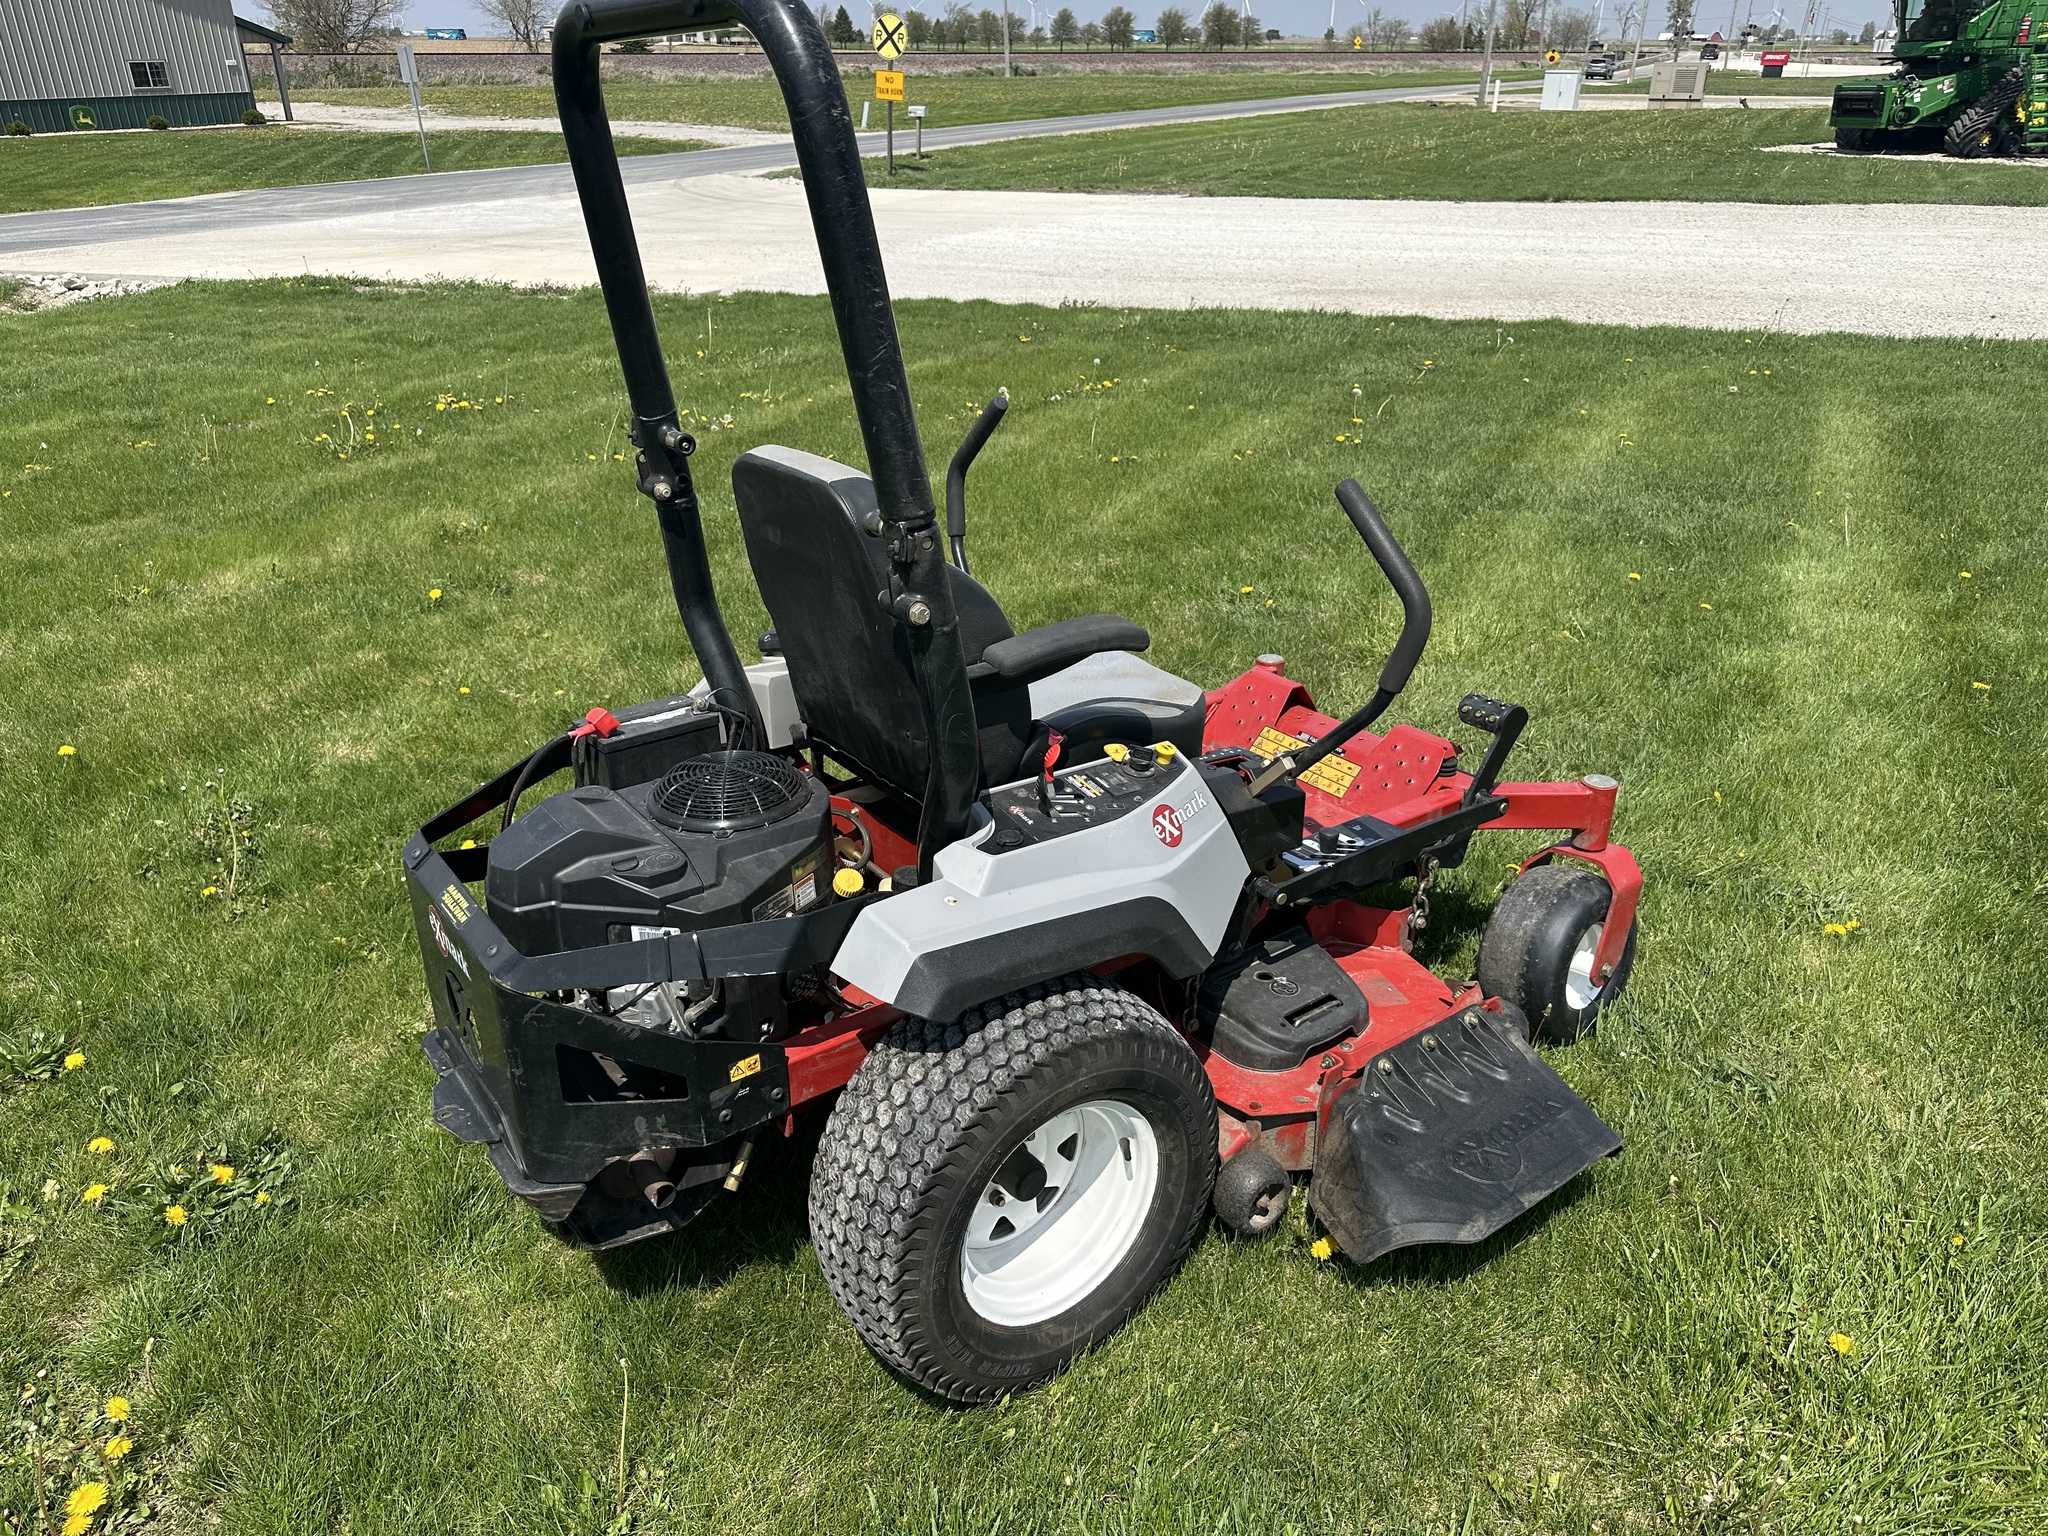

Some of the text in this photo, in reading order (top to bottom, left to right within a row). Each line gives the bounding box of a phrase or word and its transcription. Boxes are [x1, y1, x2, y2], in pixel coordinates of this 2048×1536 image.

[876, 30, 905, 44] R R
[877, 87, 889, 95] TRAIN
[885, 76, 894, 84] NO
[442, 893, 468, 923] SULLIVAN
[447, 884, 469, 910] MARTIN
[1174, 1093, 1202, 1161] KENDA
[944, 1334, 1032, 1377] SUPER TURF
